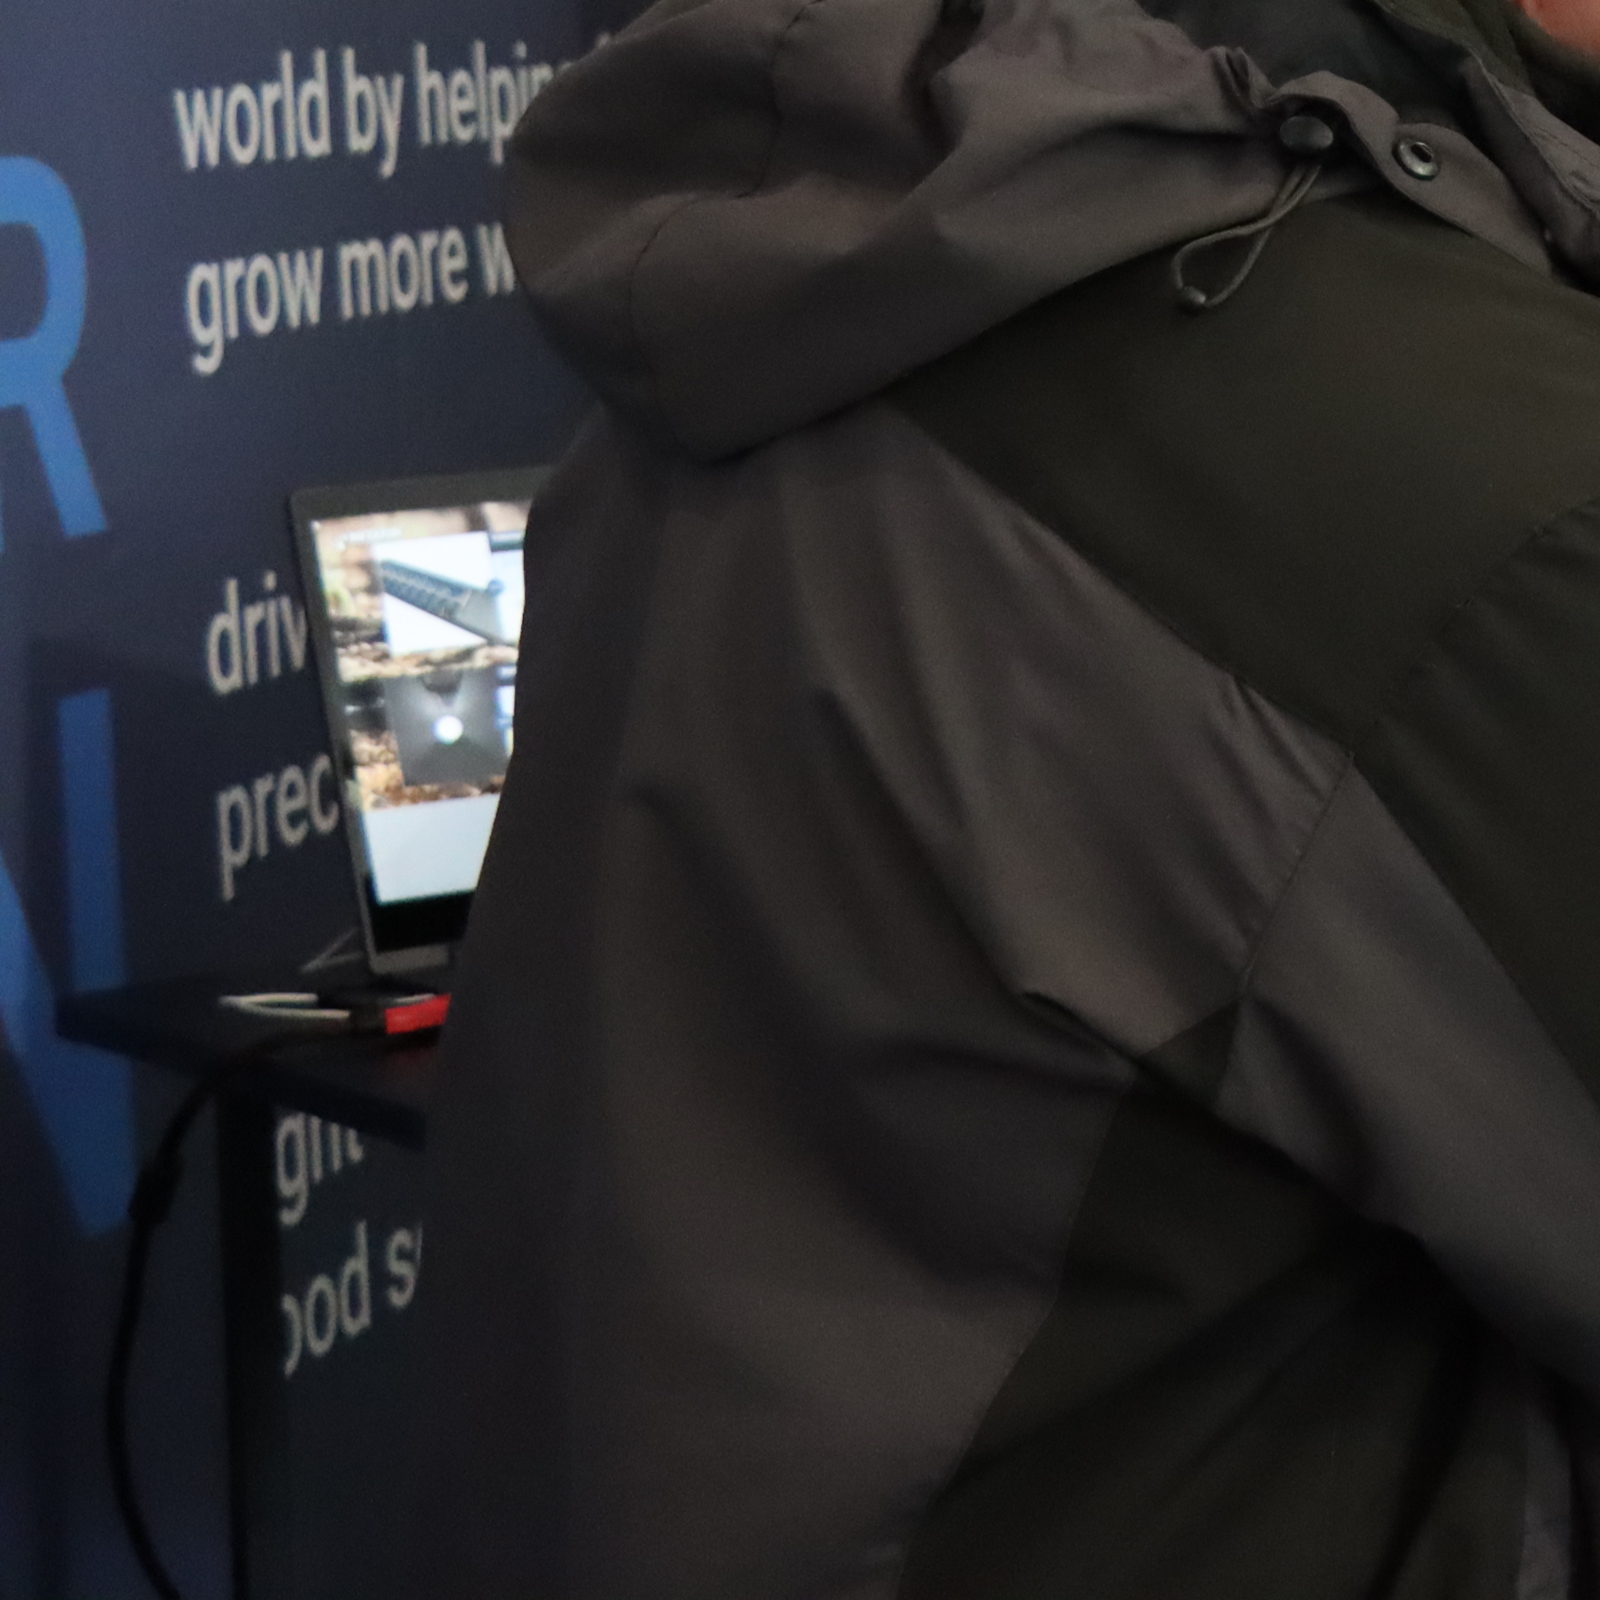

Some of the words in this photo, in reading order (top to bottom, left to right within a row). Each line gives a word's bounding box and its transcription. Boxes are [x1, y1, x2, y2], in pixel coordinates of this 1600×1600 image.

[173, 49, 332, 171] world
[341, 46, 404, 178] by
[184, 244, 325, 374] grow
[337, 224, 470, 321] more
